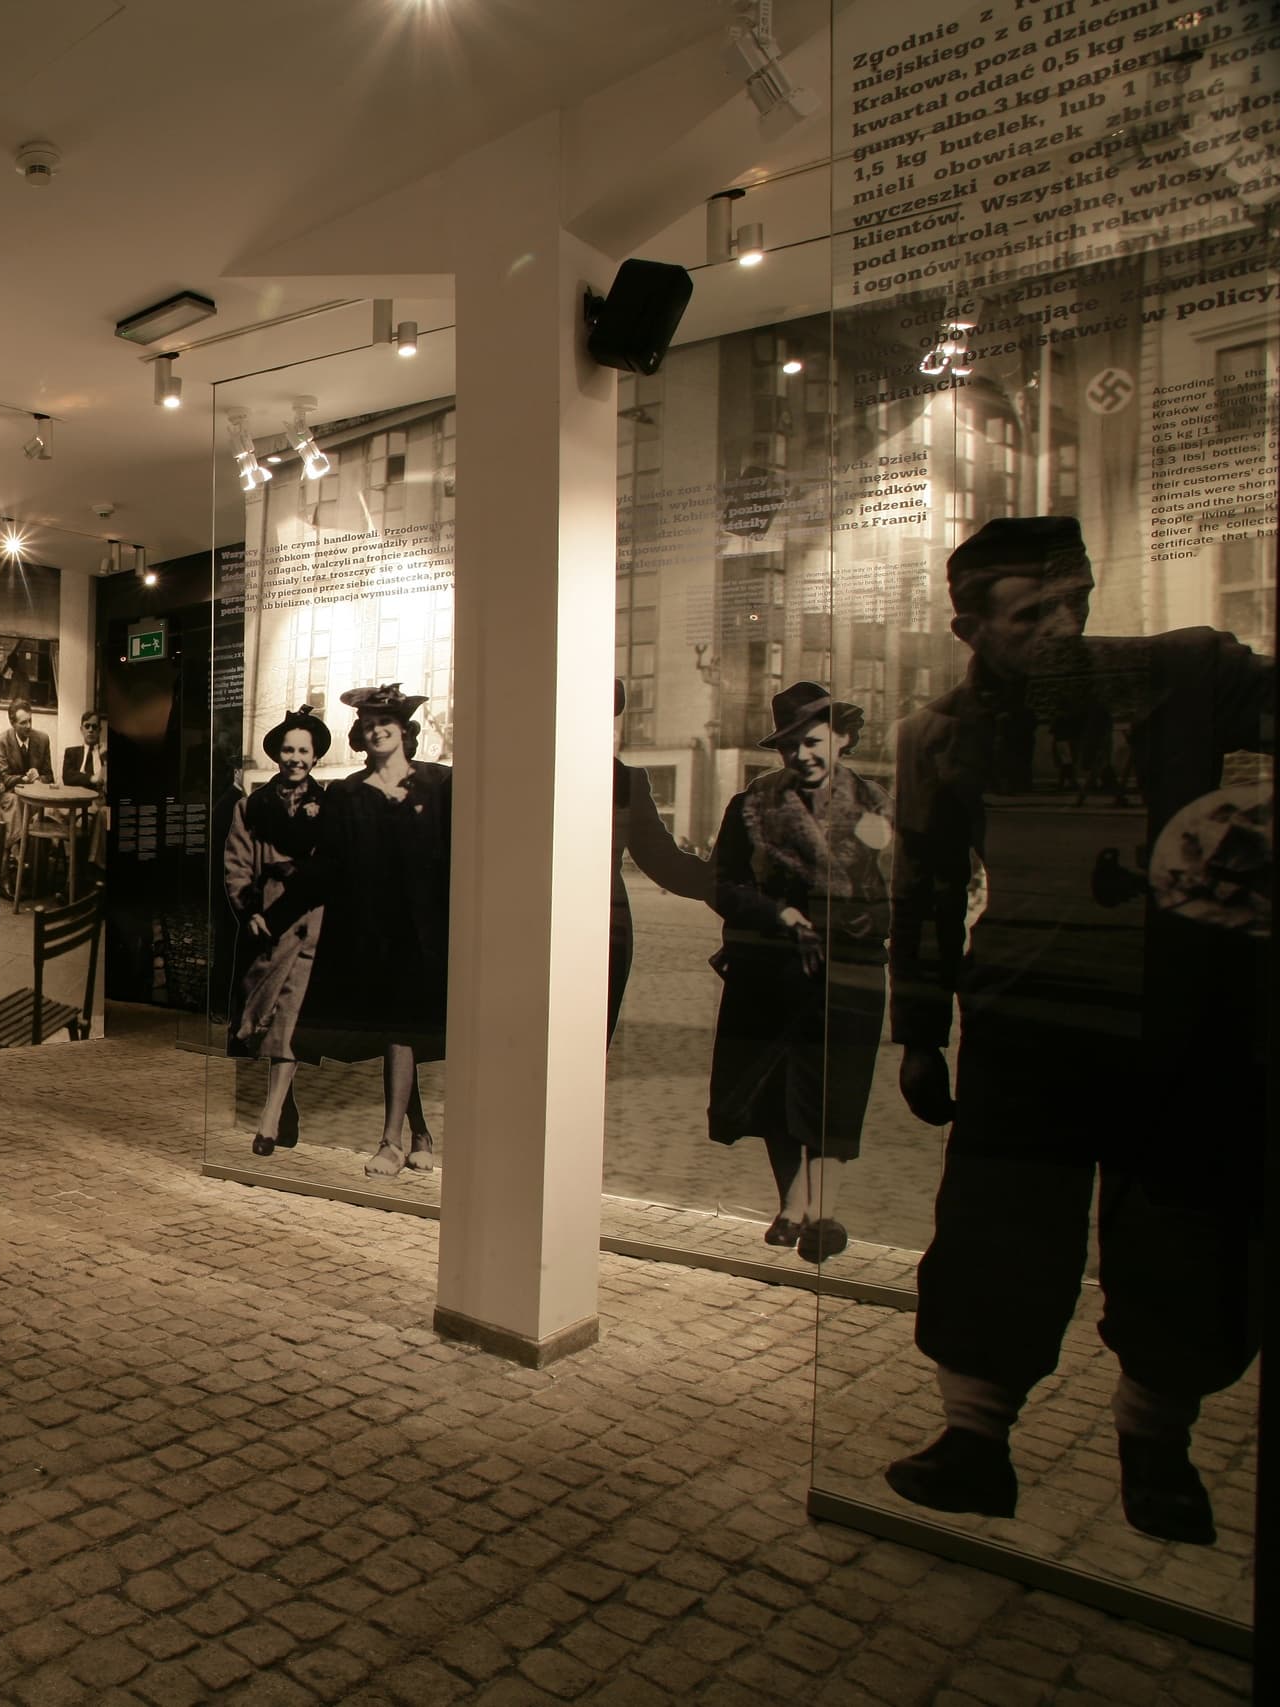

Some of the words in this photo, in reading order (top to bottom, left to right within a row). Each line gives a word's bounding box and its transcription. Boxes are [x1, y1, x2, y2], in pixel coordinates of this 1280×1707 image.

[853, 20, 959, 70] Zgodnie
[979, 8, 993, 23] z
[853, 34, 986, 93] miejskiego
[994, 27, 1008, 42] z
[1018, 15, 1032, 32] 6
[1043, 1, 1076, 24] III
[852, 68, 968, 115] Krakowa,
[974, 42, 1037, 76] poza
[1044, 0, 1158, 47] dziećmi
[955, 64, 1035, 103] oddać
[1042, 48, 1079, 73] 0,5
[1087, 36, 1125, 59] kg
[852, 129, 926, 163] gumy,
[931, 107, 987, 135] albo
[993, 97, 1008, 115] 3
[1016, 85, 1050, 107] kg
[1057, 46, 1176, 98] papieru
[1179, 24, 1232, 53] lub
[1242, 13, 1259, 33] 2
[854, 160, 884, 183] 1,5
[895, 149, 927, 170] kg
[940, 114, 1045, 156] butelek,
[1059, 92, 1106, 118] lub
[1122, 80, 1136, 98] 1
[1153, 62, 1192, 89] kg
[853, 173, 915, 206] mieli
[933, 122, 1083, 181] obowiązek
[1105, 78, 1225, 129] zbierać
[1250, 65, 1261, 85] i
[853, 178, 978, 227] wyczeszki
[993, 159, 1051, 187] oraz
[1068, 113, 1190, 165] odpadki
[853, 211, 964, 250] klientów.
[980, 165, 1119, 214] Wszystkie
[853, 248, 896, 277] pod
[901, 222, 1008, 260] kontrolą
[853, 281, 860, 296] i
[863, 256, 960, 292] ogonów
[963, 222, 1087, 267] końskich
[900, 300, 976, 329] oddać
[1142, 306, 1167, 324] w
[1152, 377, 1217, 396] According
[1152, 391, 1207, 410] governor
[1152, 421, 1176, 432] was
[1177, 429, 1194, 441] kg
[879, 450, 928, 468] Dzięki
[1152, 460, 1230, 479] hairdressers
[1235, 454, 1267, 467] were
[1151, 488, 1202, 503] animals
[1205, 483, 1236, 495] were
[1239, 478, 1276, 491] shorn
[1152, 479, 1180, 491] their
[1151, 502, 1185, 515] coats
[1187, 499, 1210, 510] and
[1213, 495, 1234, 505] the
[871, 510, 928, 528] Francji
[1151, 513, 1194, 527] People
[1202, 507, 1235, 520] living
[1151, 525, 1193, 539] deliver
[1199, 523, 1220, 533] the
[1151, 535, 1215, 551] certificate
[1222, 531, 1249, 542] that
[1150, 550, 1198, 562] station.
[302, 572, 327, 583] teraz
[277, 586, 319, 599] pieczone
[320, 583, 346, 594] przez
[346, 578, 375, 590] siebie
[313, 591, 360, 605] Okupacja
